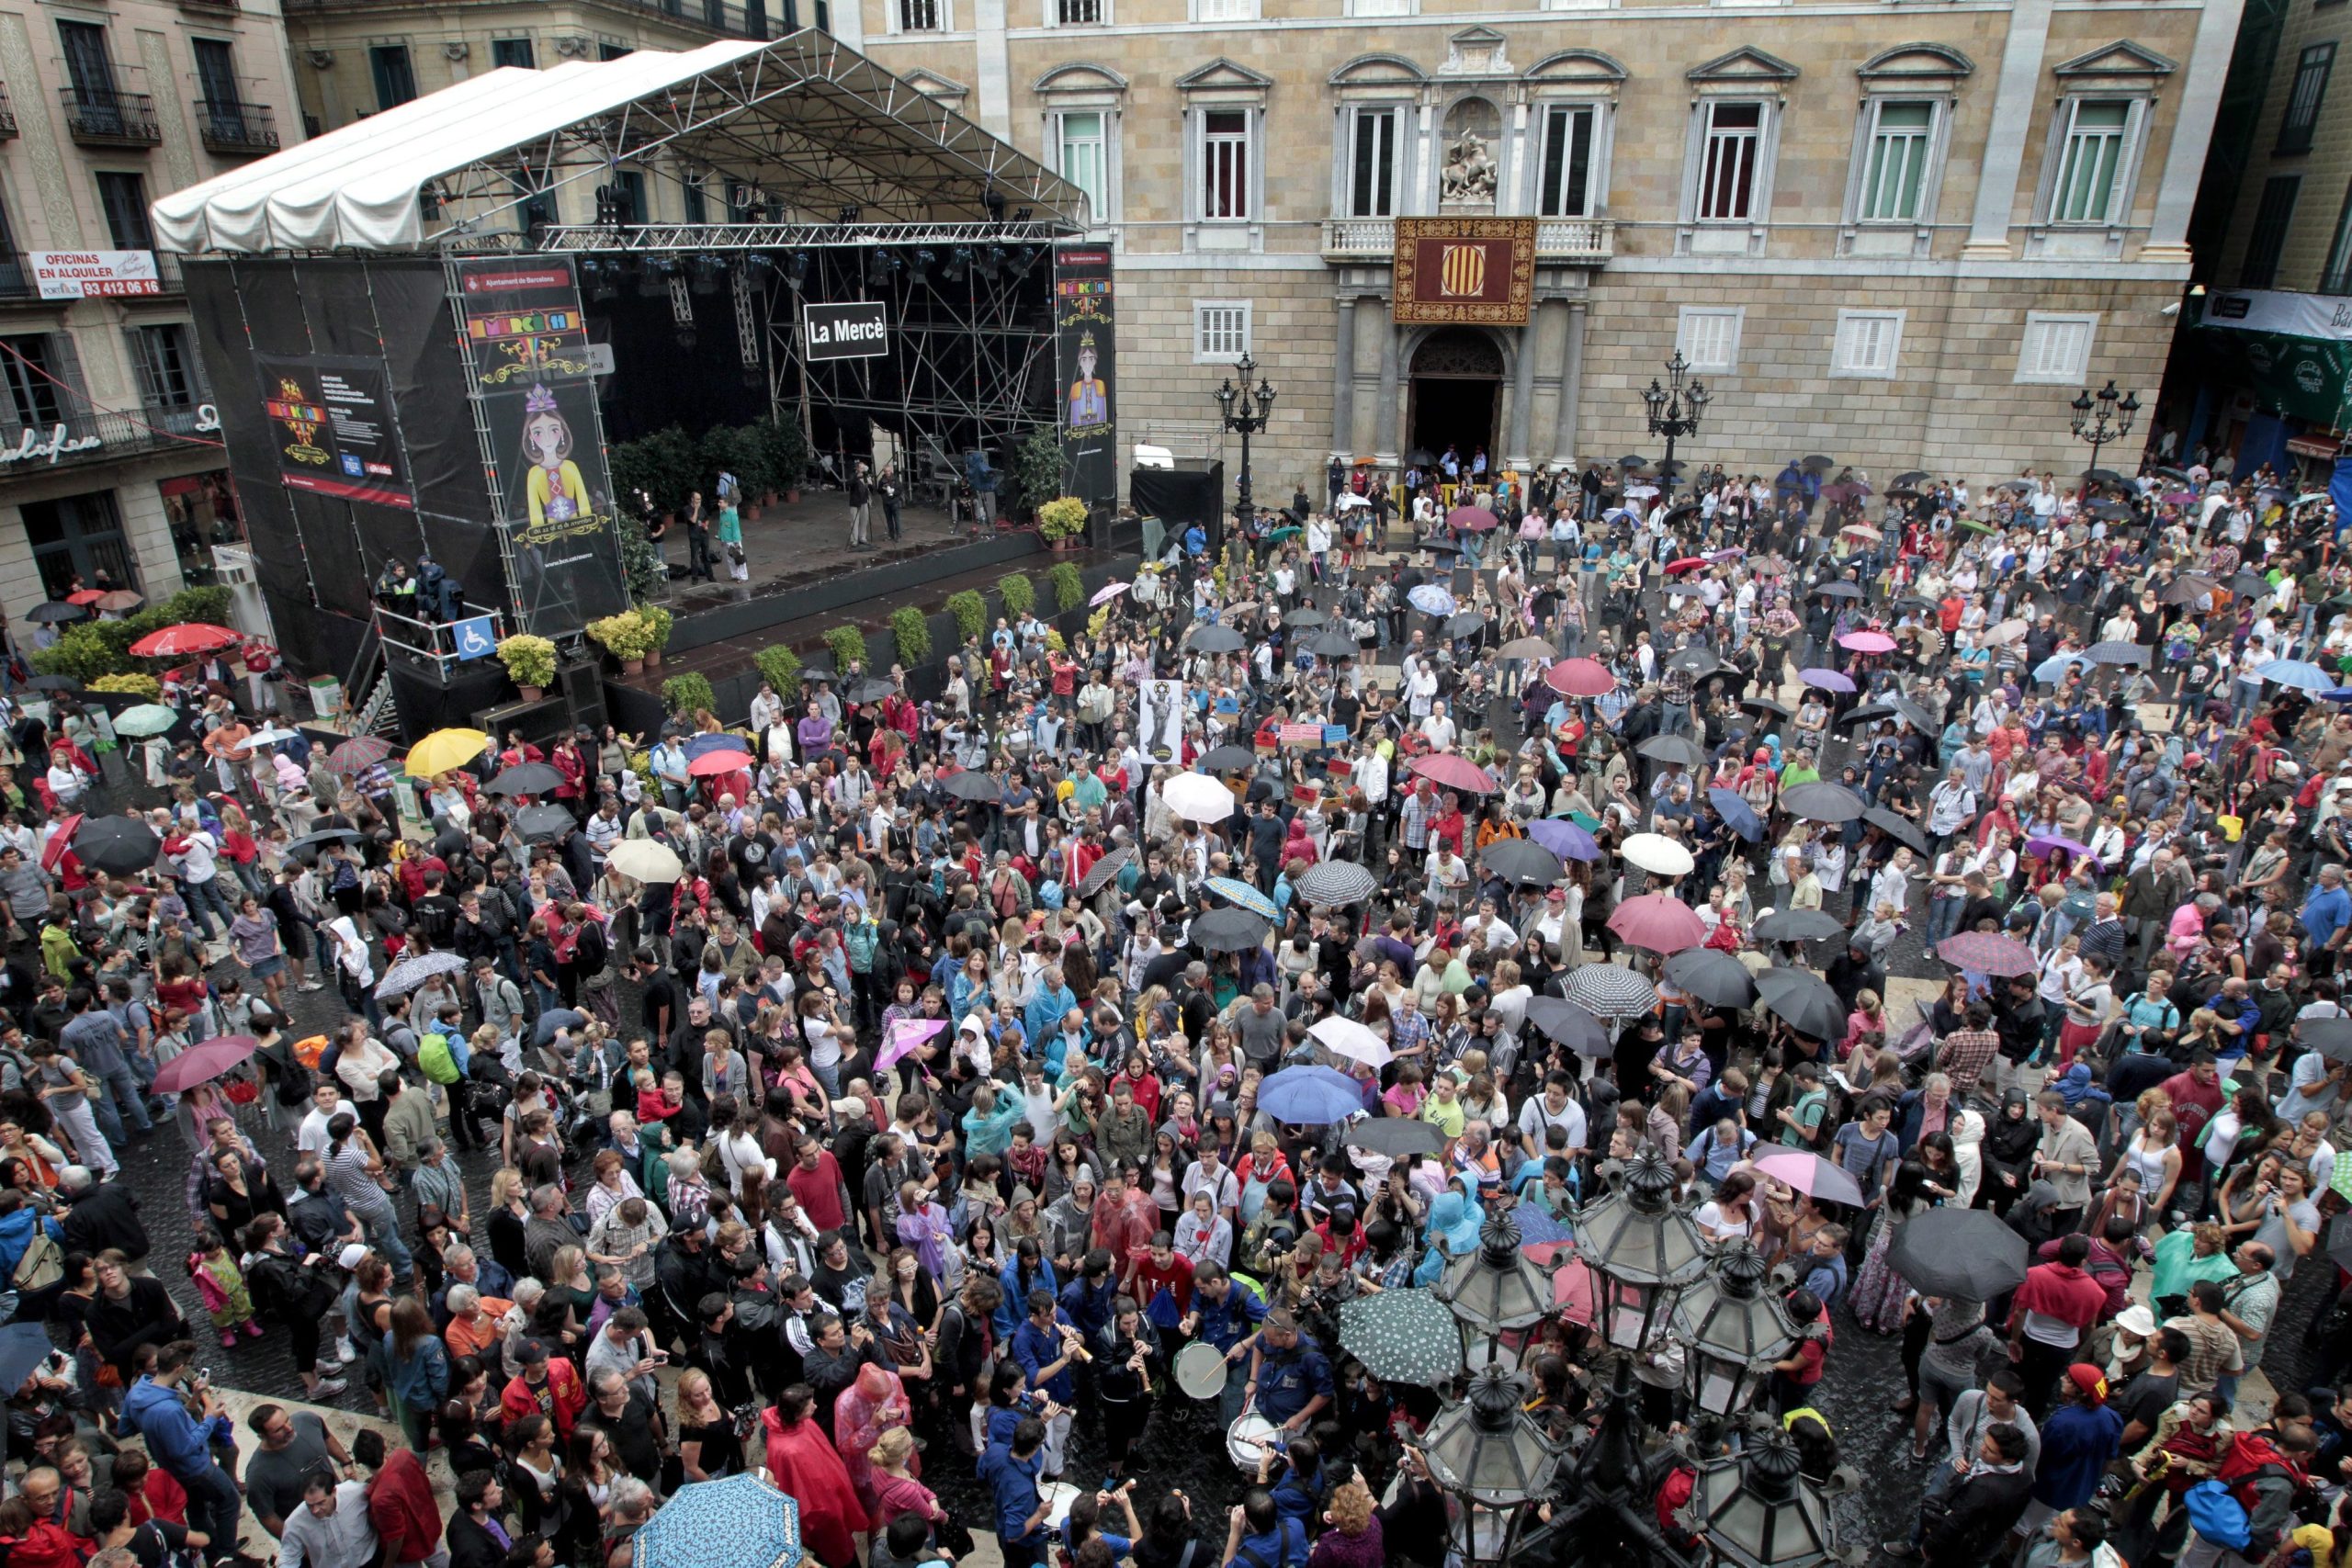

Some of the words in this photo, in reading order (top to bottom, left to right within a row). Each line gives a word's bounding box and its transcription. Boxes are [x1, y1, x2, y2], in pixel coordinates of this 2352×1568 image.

[46, 254, 99, 265] OFICINAS
[39, 268, 55, 278] EN
[59, 267, 114, 278] ALQUILER
[84, 282, 100, 295] 93
[103, 282, 126, 294] 412
[126, 281, 142, 293] 06
[144, 280, 160, 293] 16
[486, 278, 518, 288] Ajuntament
[809, 321, 830, 344] La
[833, 316, 884, 342] Mercè
